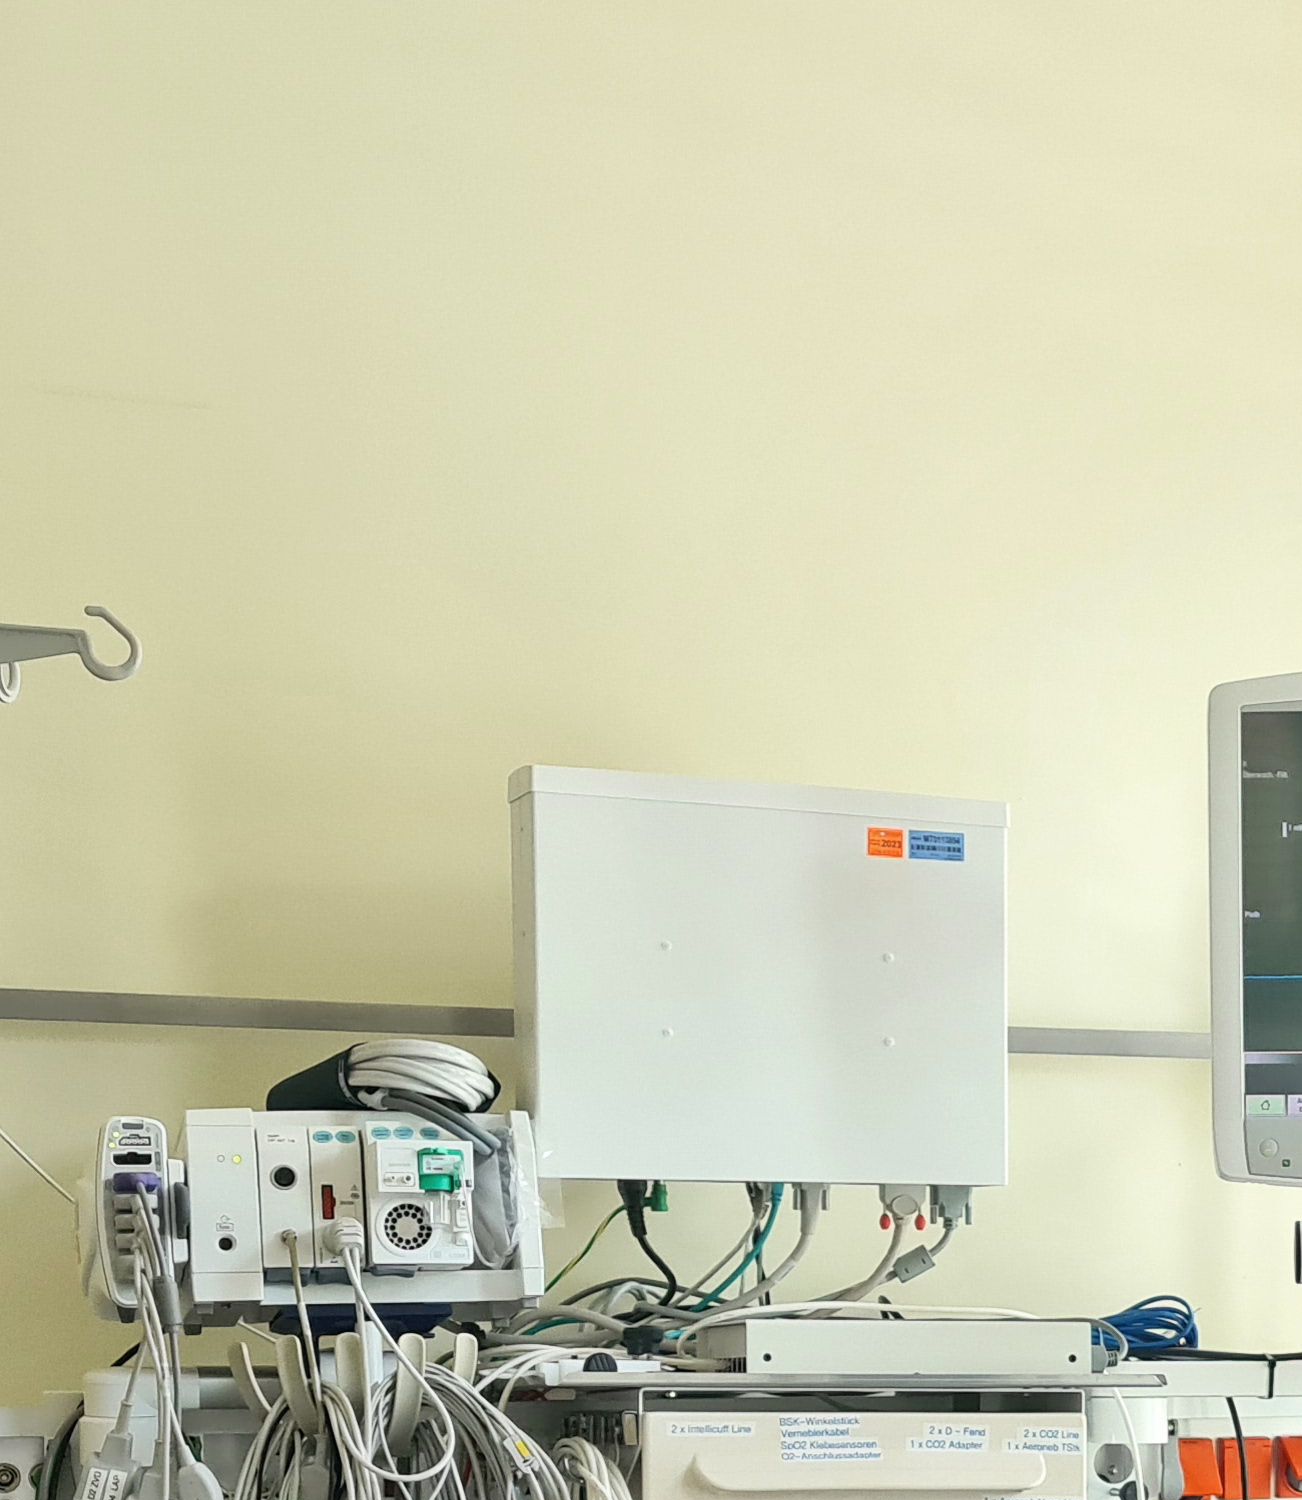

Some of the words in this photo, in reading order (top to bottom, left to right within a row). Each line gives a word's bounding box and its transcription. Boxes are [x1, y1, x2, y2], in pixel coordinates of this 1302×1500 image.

[671, 1425, 678, 1433] 2
[732, 1425, 752, 1433] Line
[929, 1426, 935, 1434] 2
[946, 1426, 952, 1435] D
[964, 1427, 986, 1436] Fend
[1024, 1430, 1030, 1438] 2
[1039, 1430, 1059, 1438] CO2
[1062, 1430, 1080, 1439] Line
[925, 1440, 946, 1448] CO2
[948, 1440, 983, 1450] Adapter
